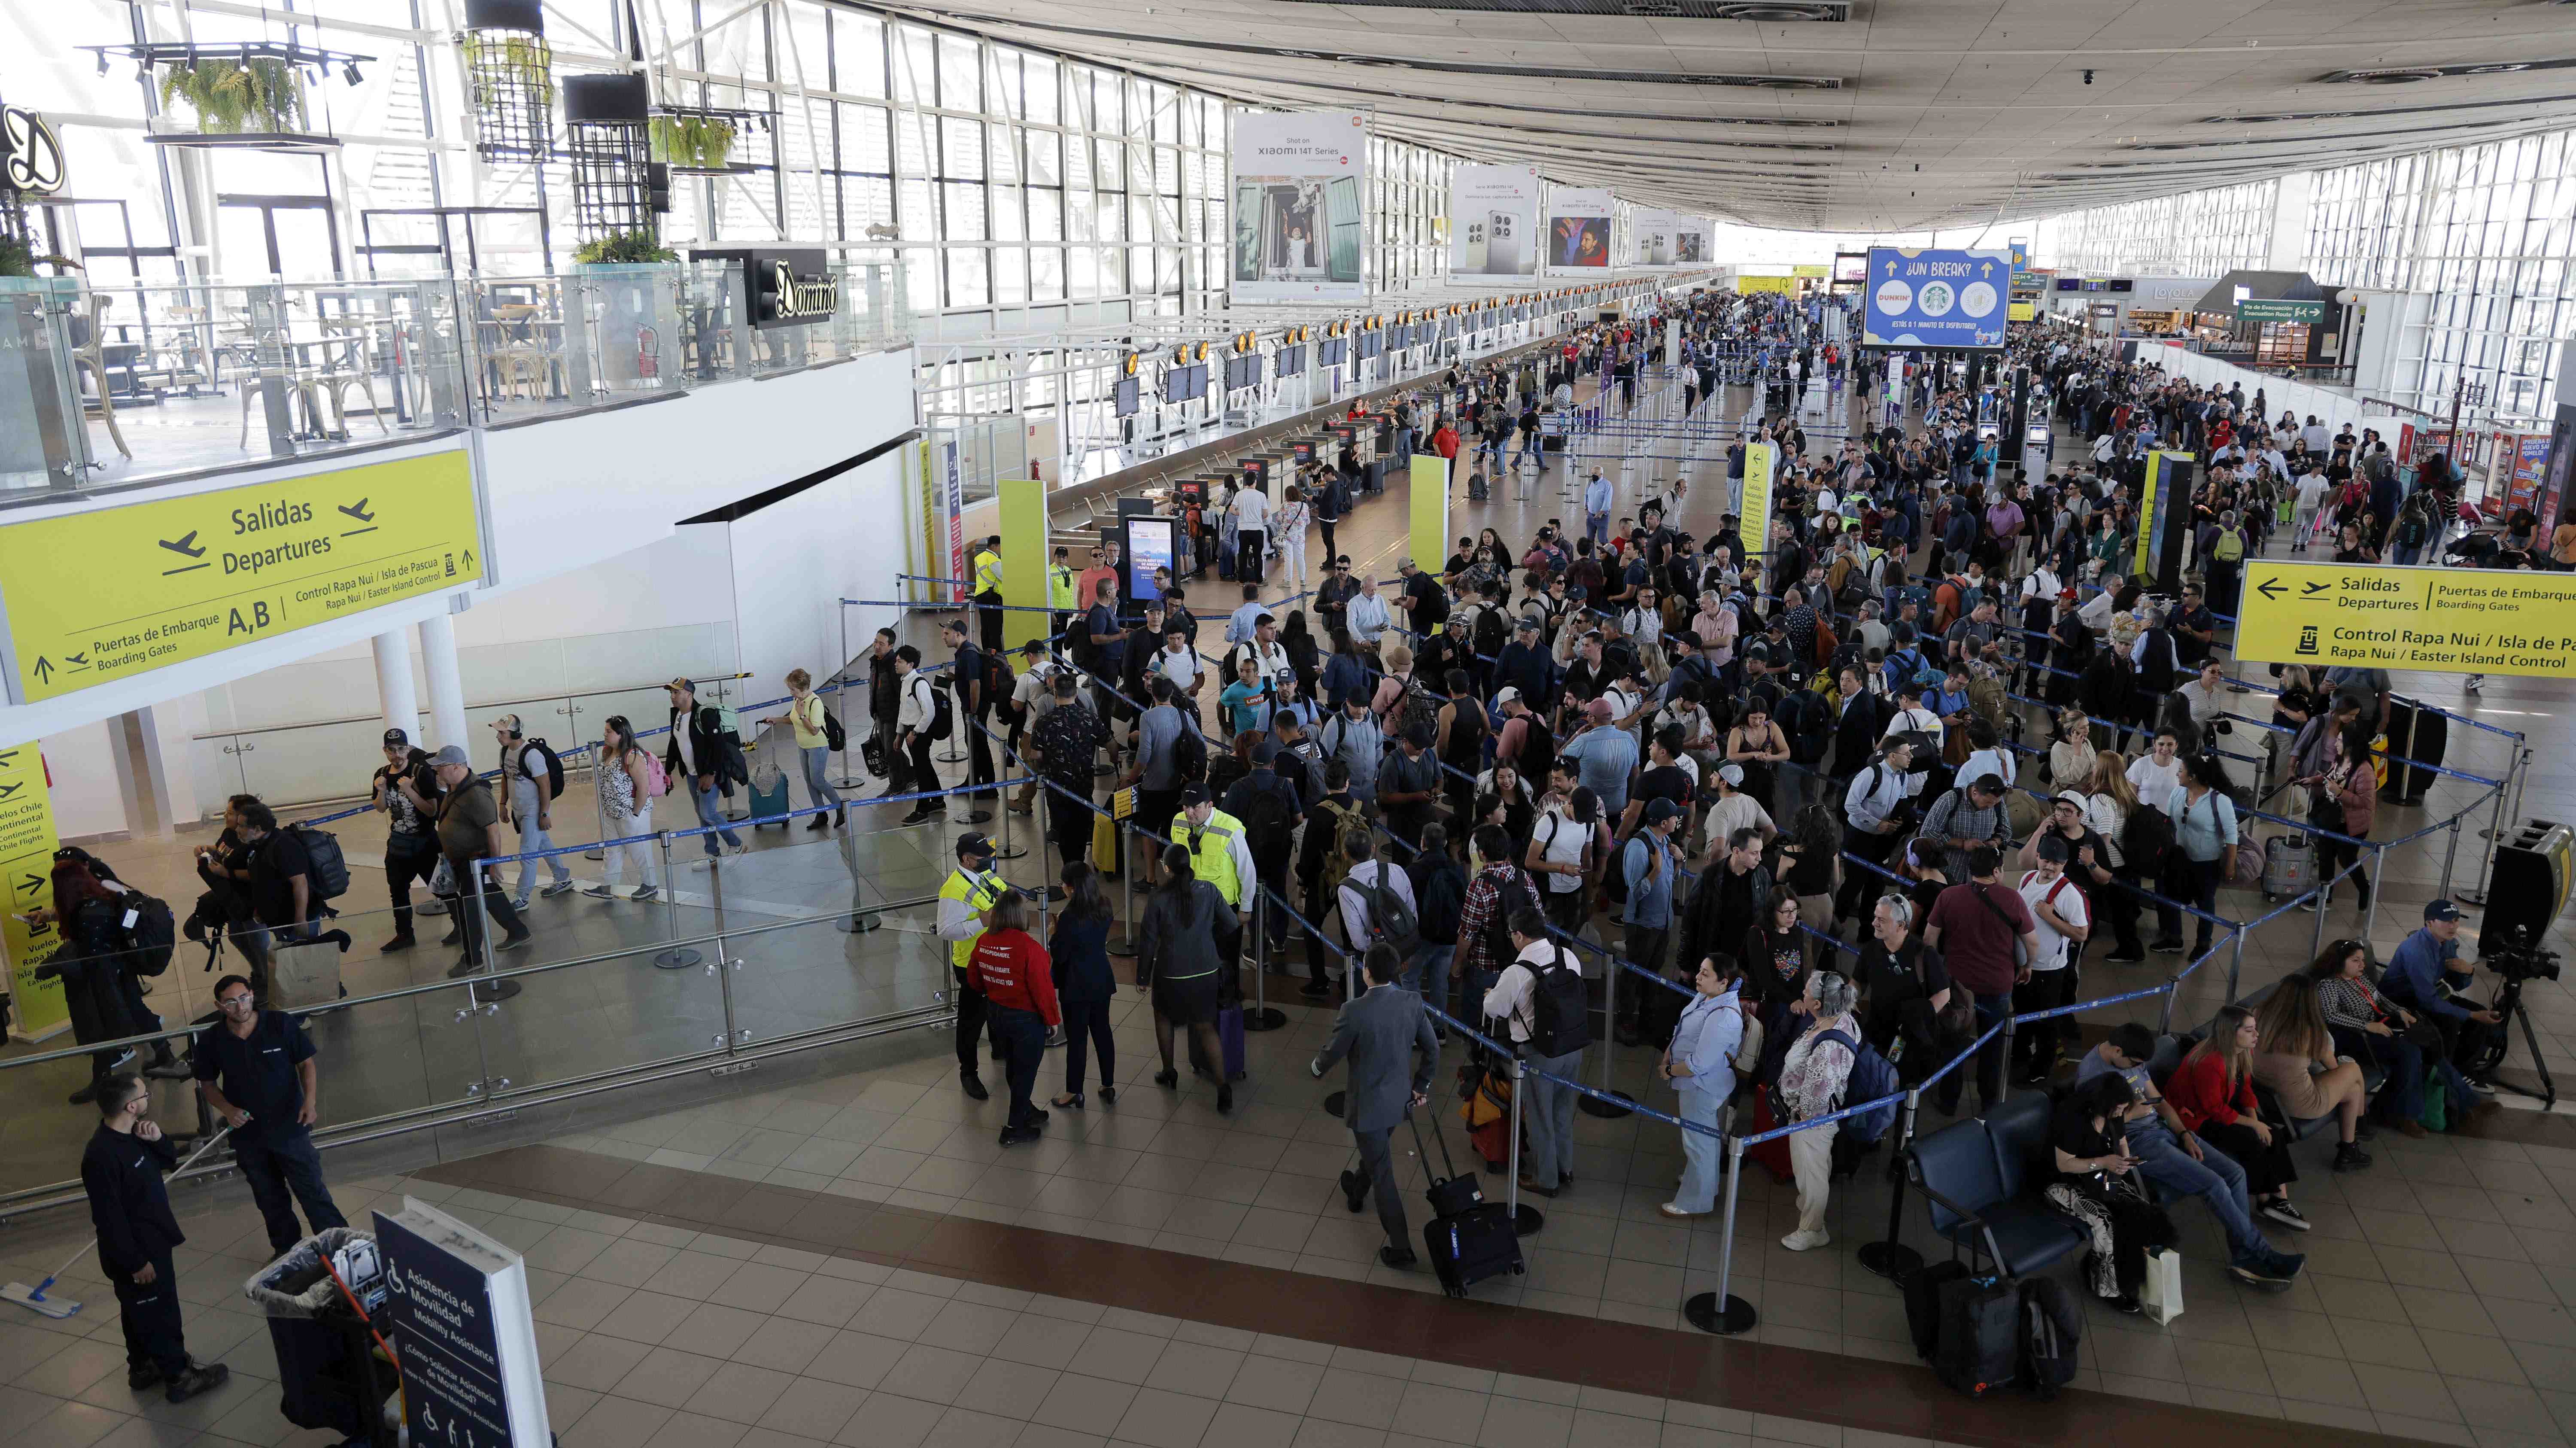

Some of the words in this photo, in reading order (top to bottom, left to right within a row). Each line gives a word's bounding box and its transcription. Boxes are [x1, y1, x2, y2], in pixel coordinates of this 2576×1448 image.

[1906, 262, 1927, 276] ¿UN
[1931, 262, 1972, 277] BREAK?
[776, 262, 837, 316] Dominó
[2517, 471, 2536, 479] POMELO
[1745, 491, 1764, 500] Nacionales
[1749, 483, 1761, 491] Salidas
[231, 499, 313, 535] Salidas
[222, 536, 331, 575] Departures
[295, 583, 331, 602] Control
[333, 580, 356, 593] Rapa
[358, 572, 374, 586] Nui
[376, 571, 379, 582] /
[382, 568, 396, 580] Isla
[398, 565, 408, 575] de
[411, 558, 438, 572] Pascua
[326, 598, 346, 610] Rapa
[348, 592, 361, 604] Nui
[363, 591, 365, 600] /
[368, 585, 391, 599] Easter
[392, 578, 413, 592] Island
[415, 571, 440, 586] Control
[2341, 577, 2401, 592] Salidas
[2338, 596, 2419, 611] Departures
[2436, 599, 2485, 612] Boarding
[2489, 602, 2520, 611] Gates
[2438, 585, 2487, 598] Puertas
[2491, 587, 2508, 598] de
[2512, 588, 2576, 603] Embarque
[93, 634, 141, 654] Puertas
[144, 628, 159, 642] de
[162, 614, 220, 637] Embarque
[227, 601, 270, 636] A,B
[2333, 627, 2396, 642] Control
[2402, 630, 2444, 646] Rapa
[2450, 633, 2480, 646] Nui
[2486, 634, 2493, 648] /
[2498, 635, 2527, 649] Isla
[2533, 636, 2555, 650] de
[97, 650, 146, 671] Boarding
[149, 643, 178, 658] Gates
[2330, 645, 2366, 660] Rapa
[2371, 648, 2396, 660] Nui
[2401, 649, 2406, 660] /
[2411, 650, 2456, 662] Easter
[2461, 652, 2504, 665] Island
[2509, 654, 2566, 668] Control
[21, 803, 43, 813] Chile
[0, 842, 18, 851] Chile
[20, 834, 44, 846] Flights
[28, 938, 58, 952] Vuelos
[23, 954, 45, 966] Rapa
[17, 970, 32, 980] Isla
[407, 1268, 459, 1308] Asistencia
[461, 1300, 475, 1317] de
[410, 1287, 462, 1328] Movilidad
[414, 1308, 448, 1339] Mobility
[451, 1331, 495, 1365] Assistance
[405, 1344, 428, 1363] ¿Cómo
[429, 1357, 458, 1381] Solicitar
[460, 1376, 497, 1406] Asistencia
[427, 1368, 436, 1379] de
[437, 1373, 477, 1405] Movilidad?
[449, 1395, 472, 1417] Mobility
[473, 1410, 506, 1436] Assistance?
